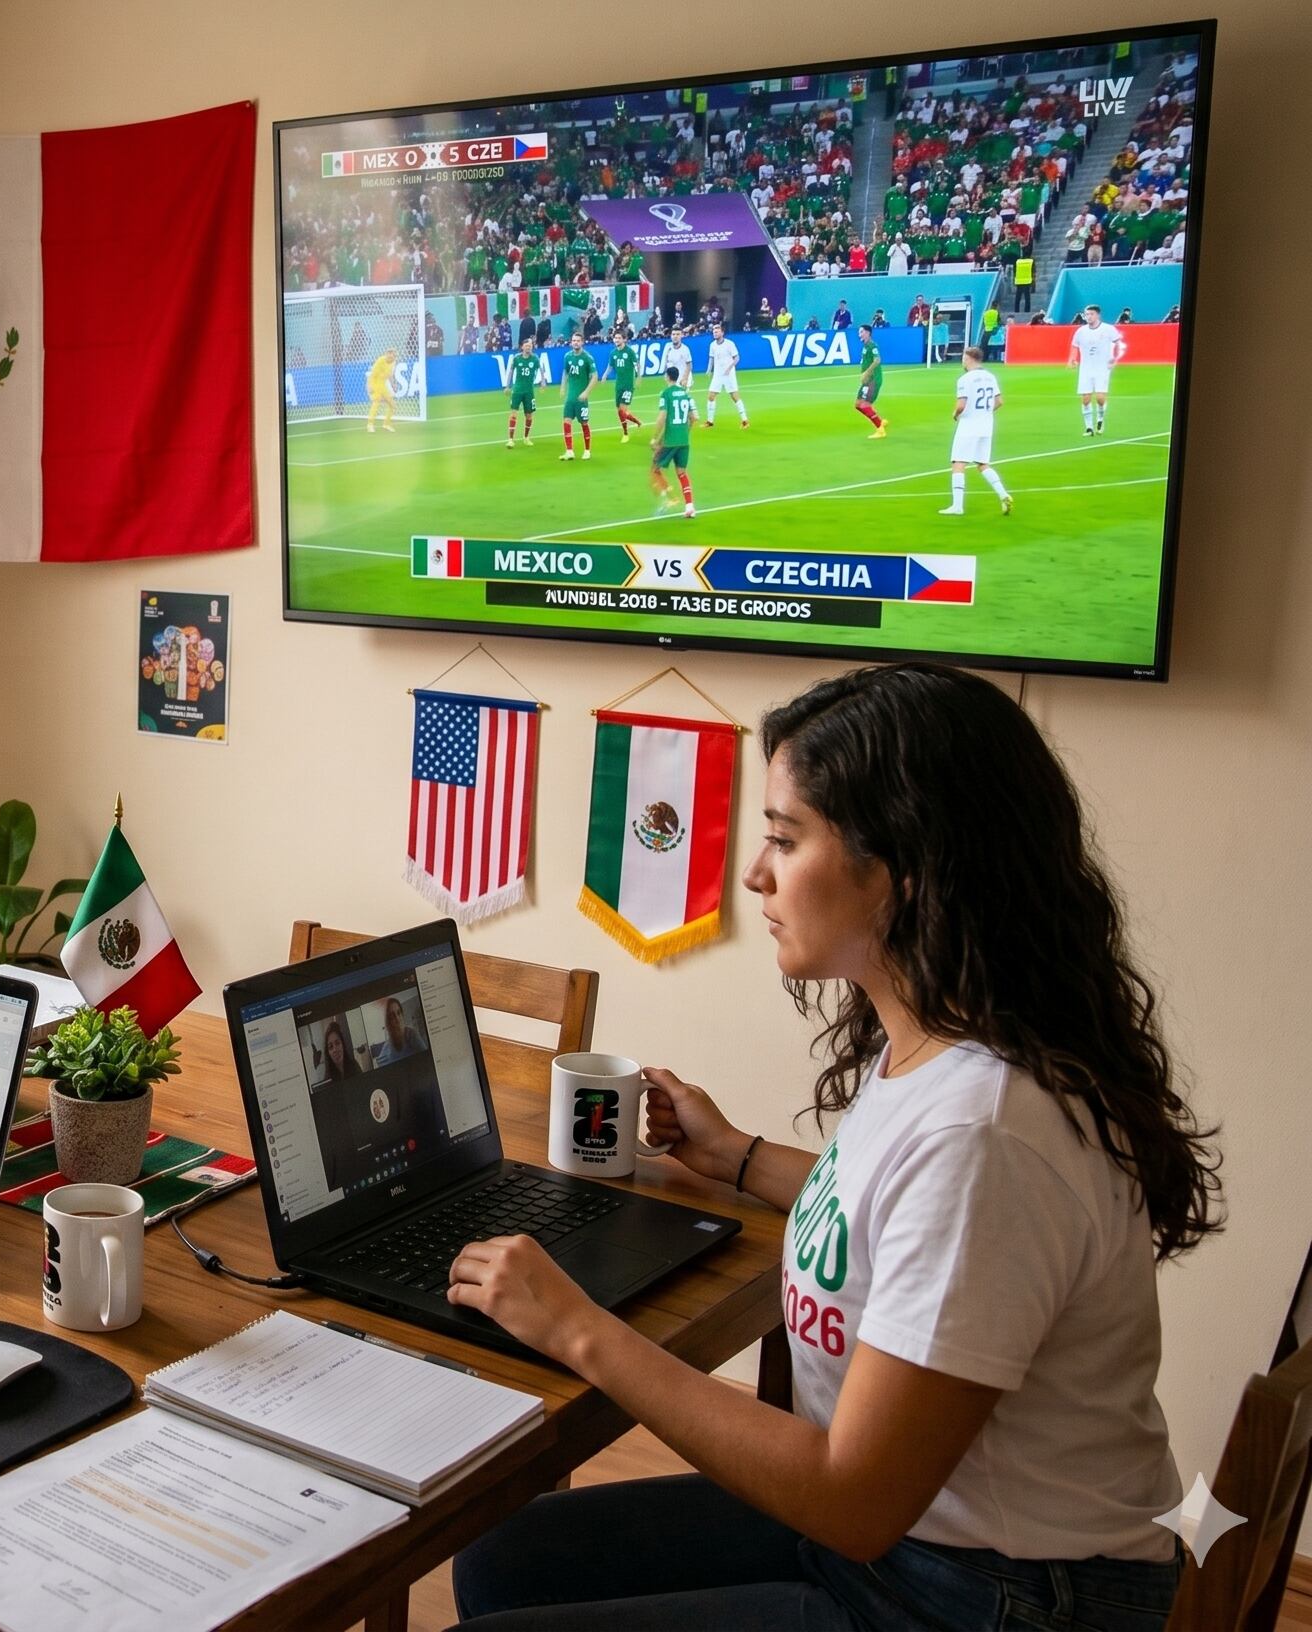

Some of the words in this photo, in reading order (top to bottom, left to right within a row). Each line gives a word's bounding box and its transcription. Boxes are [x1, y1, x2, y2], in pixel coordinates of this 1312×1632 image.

[1084, 100, 1126, 117] LIVE
[363, 152, 399, 169] MEX
[449, 147, 460, 163] 5
[761, 332, 851, 367] VISA
[491, 352, 553, 387] VA
[672, 399, 690, 424] 19
[494, 550, 593, 575] MEXICO
[653, 559, 682, 578] VS
[745, 559, 872, 589] CZECHIA
[714, 598, 738, 614] DE
[740, 600, 811, 619] GROPOS
[783, 1268, 845, 1357] 026
